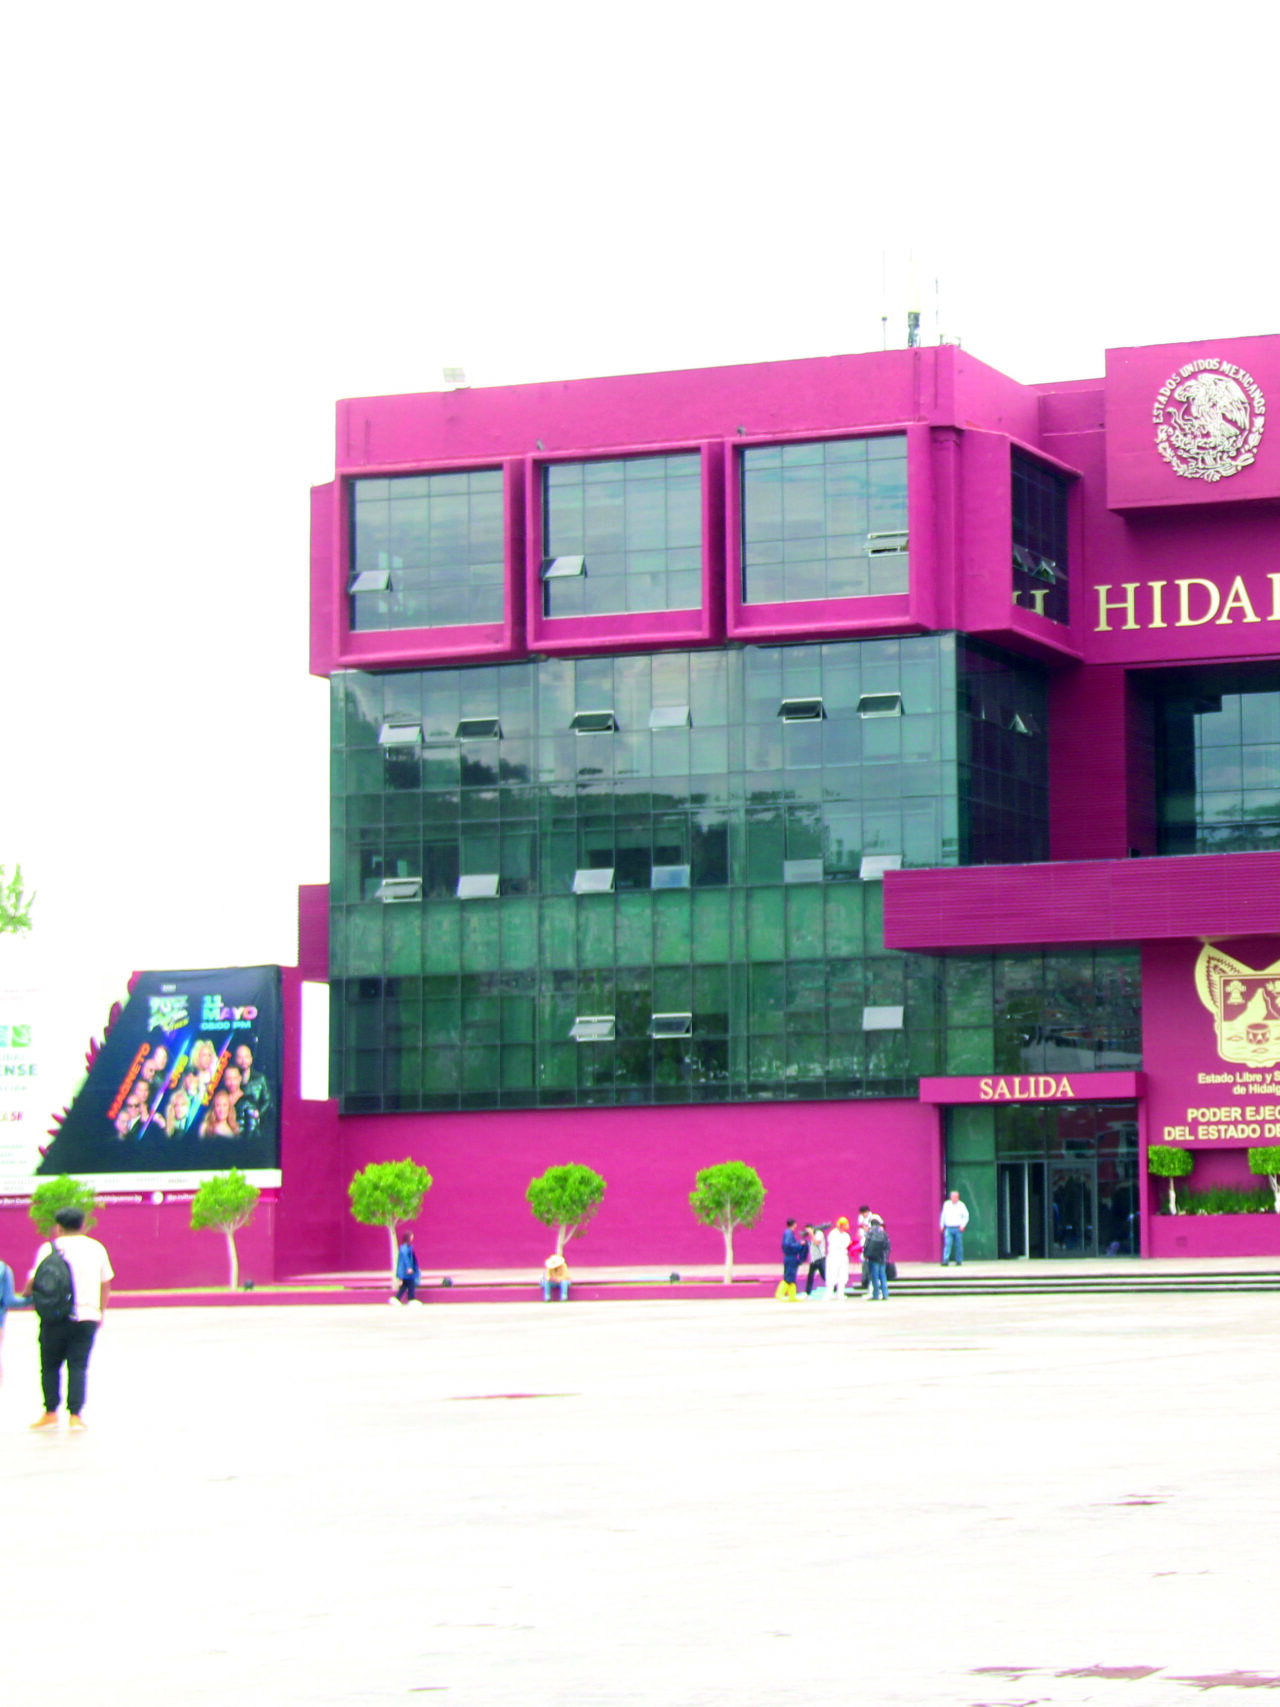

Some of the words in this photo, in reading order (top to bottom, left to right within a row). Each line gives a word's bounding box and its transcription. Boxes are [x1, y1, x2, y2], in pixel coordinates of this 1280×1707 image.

[1152, 373, 1182, 424] ESTADOS
[1179, 358, 1221, 378] UNIDOS
[1219, 360, 1266, 415] MEXICANOS
[202, 1006, 258, 1020] MAYO
[232, 1020, 252, 1030] PM
[1197, 1072, 1234, 1084] Estado
[1236, 1071, 1262, 1083] Libre
[1264, 1074, 1273, 1087] y
[980, 1076, 1075, 1100] SALIDA
[1232, 1084, 1247, 1095] de
[1187, 1106, 1243, 1123] PODER
[1163, 1125, 1195, 1141] DEL
[1197, 1123, 1261, 1140] ESTADO
